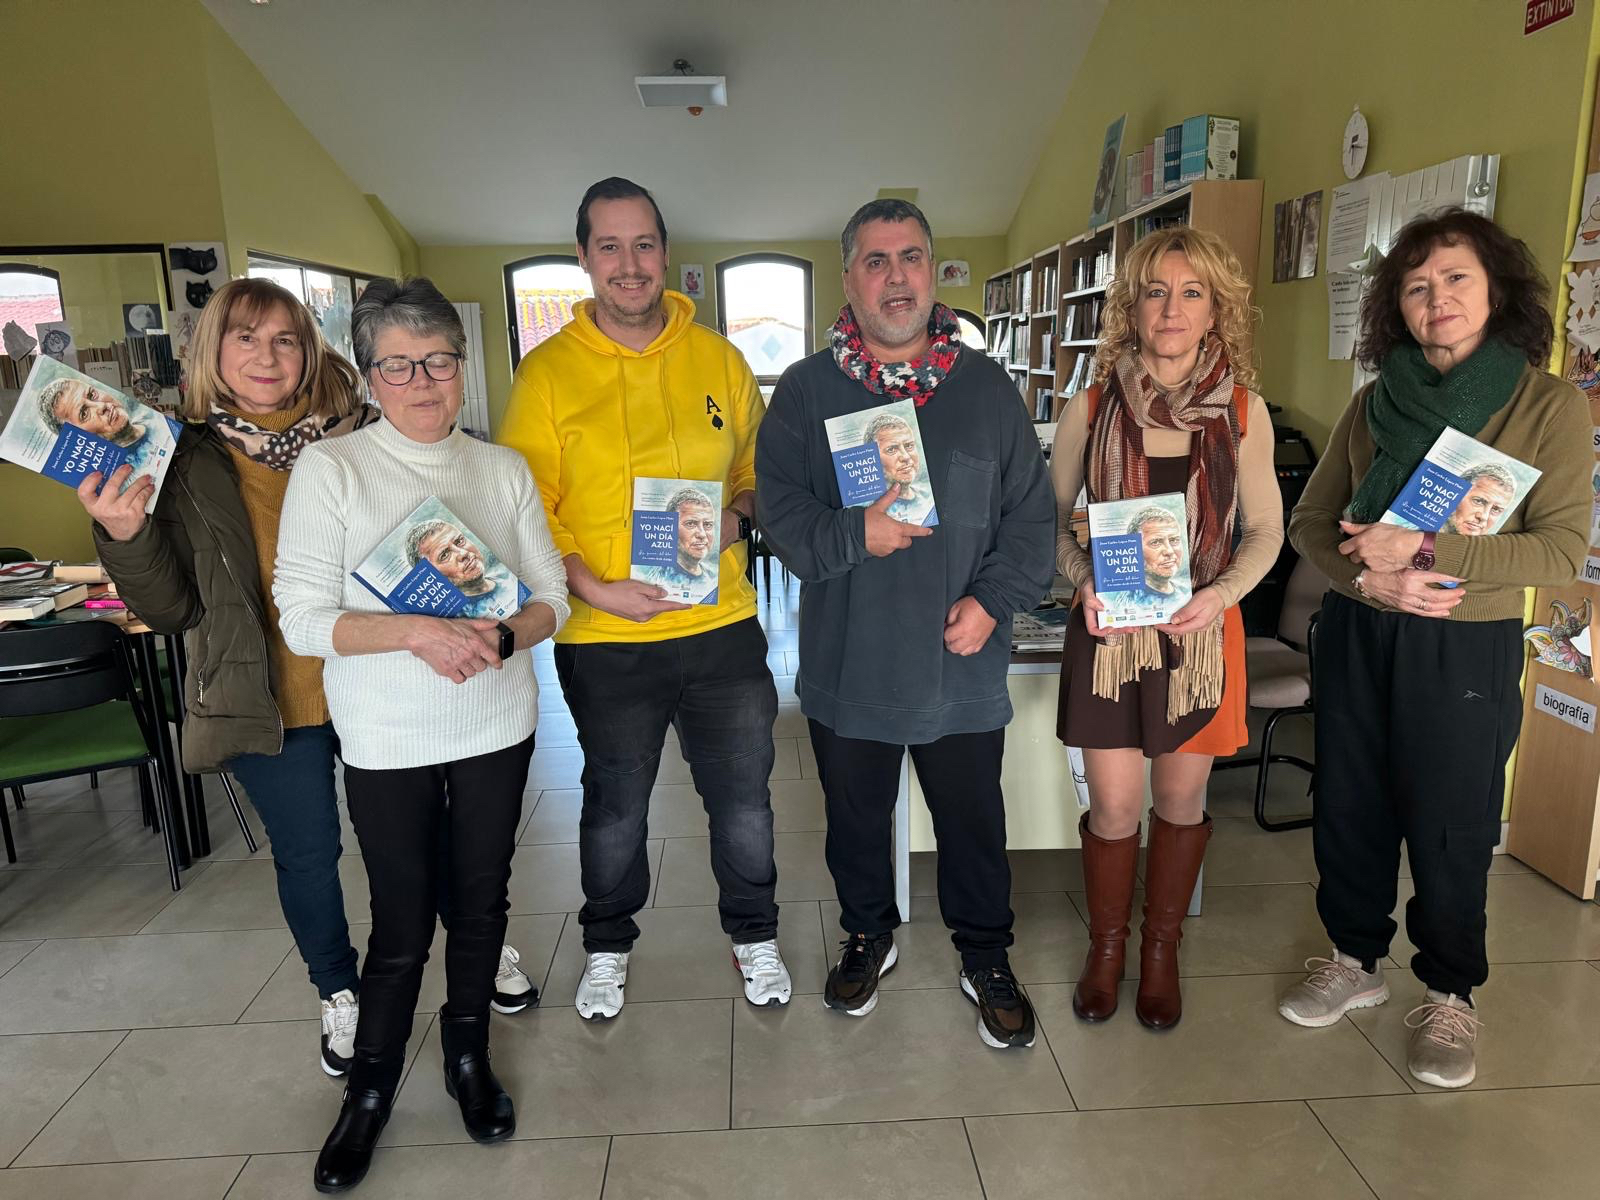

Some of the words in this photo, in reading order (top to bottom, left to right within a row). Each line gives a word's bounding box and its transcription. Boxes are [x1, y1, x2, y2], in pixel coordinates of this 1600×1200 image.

[706, 394, 722, 414] A
[63, 460, 75, 473] YO
[71, 434, 87, 459] NACÍ
[76, 458, 89, 473] UN
[84, 441, 97, 457] DÍA
[92, 446, 106, 470] AZUL
[842, 462, 853, 470] YO
[856, 456, 876, 466] NACÍ
[858, 476, 880, 485] AZUL
[863, 465, 878, 476] DÍA
[1419, 488, 1433, 498] UN
[1434, 496, 1450, 508] DÍA
[1420, 476, 1433, 487] YO
[1434, 484, 1458, 500] NACÍ
[1420, 500, 1444, 516] AZUL
[1116, 547, 1137, 556] NACÍ
[1123, 556, 1138, 565] DÍA
[405, 594, 417, 605] YO
[417, 572, 436, 594] NACÍ
[417, 596, 429, 608] UN
[428, 581, 444, 596] DÍA
[431, 589, 451, 609] AZUL
[1544, 692, 1589, 724] biografía
